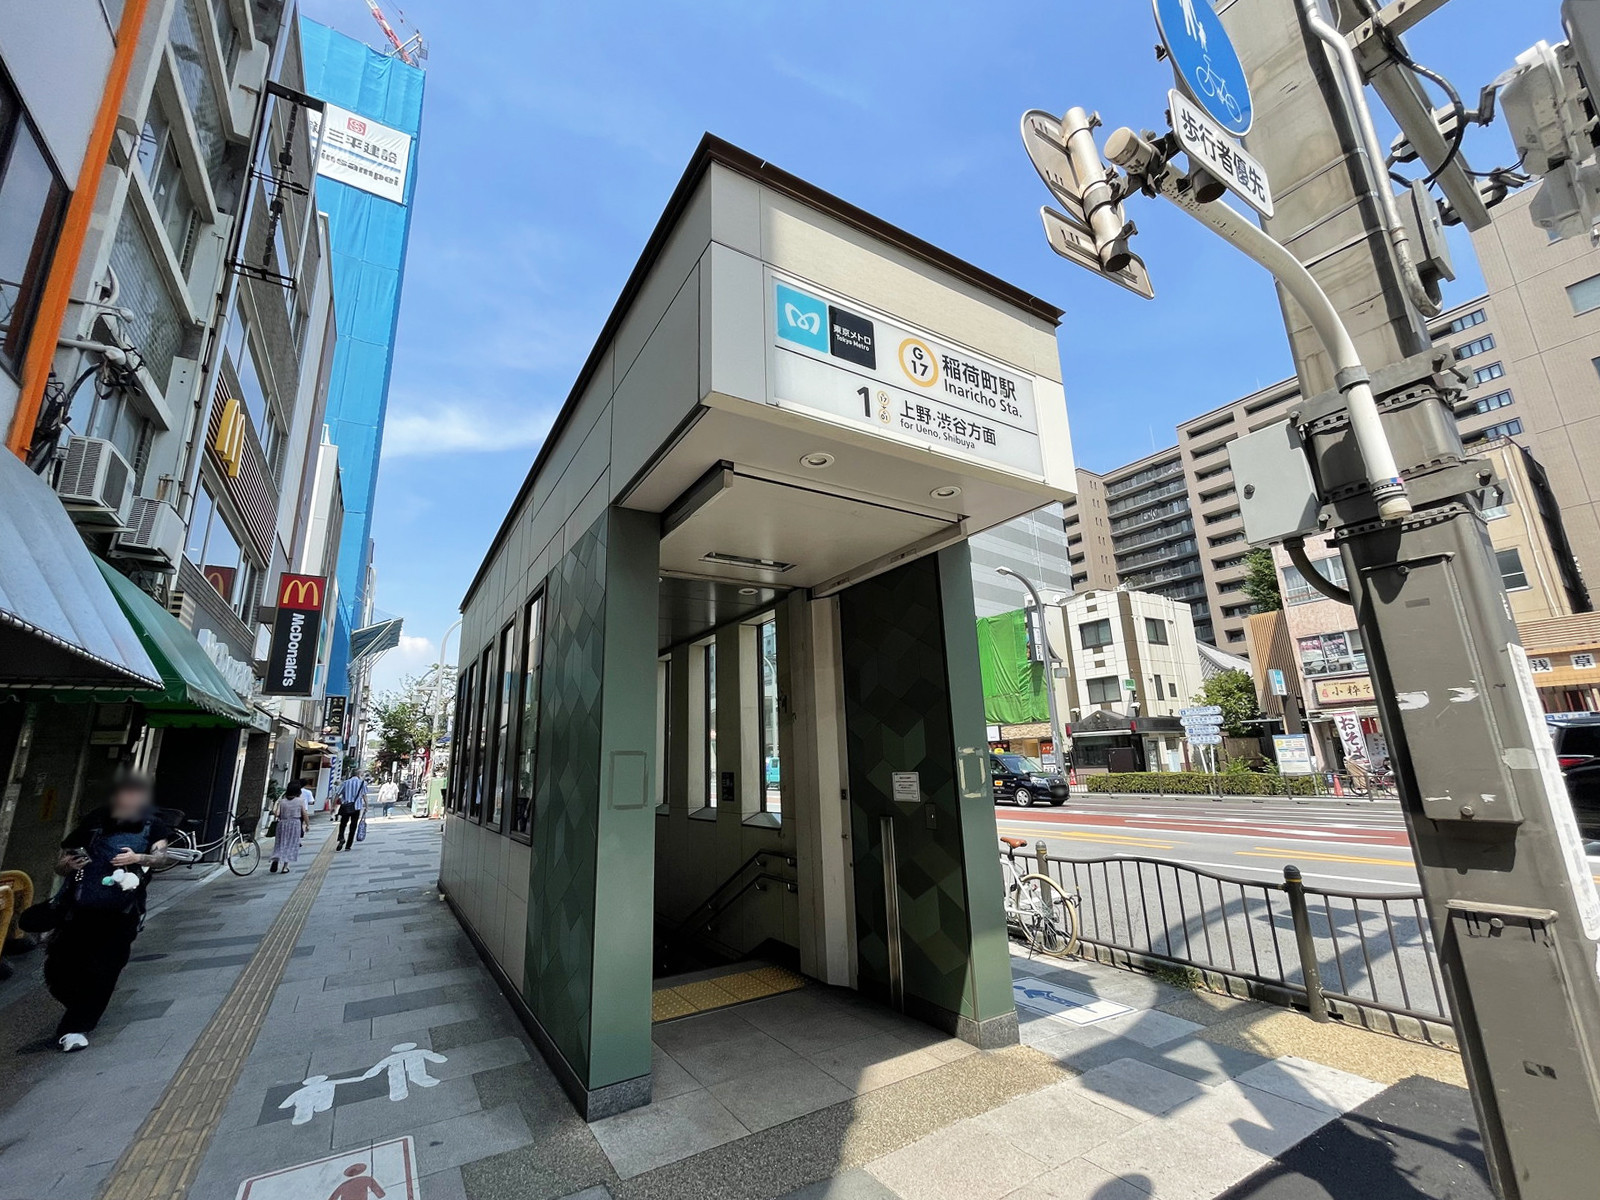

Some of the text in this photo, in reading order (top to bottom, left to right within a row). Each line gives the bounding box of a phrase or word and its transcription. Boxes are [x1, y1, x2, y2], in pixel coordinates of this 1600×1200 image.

[313, 147, 399, 186] insampei
[1181, 108, 1266, 203] 歩行者優先
[833, 324, 872, 345] 東京メトロ
[836, 334, 870, 352] Tokyo Metro
[911, 360, 929, 377] 17
[913, 347, 924, 361] G
[942, 354, 1017, 401] 稲荷町駅
[857, 386, 871, 418] 1
[944, 379, 1023, 418] Inaricho Sta.
[900, 418, 976, 450] for Ueno, Shibuya
[282, 613, 305, 687] McDonald's
